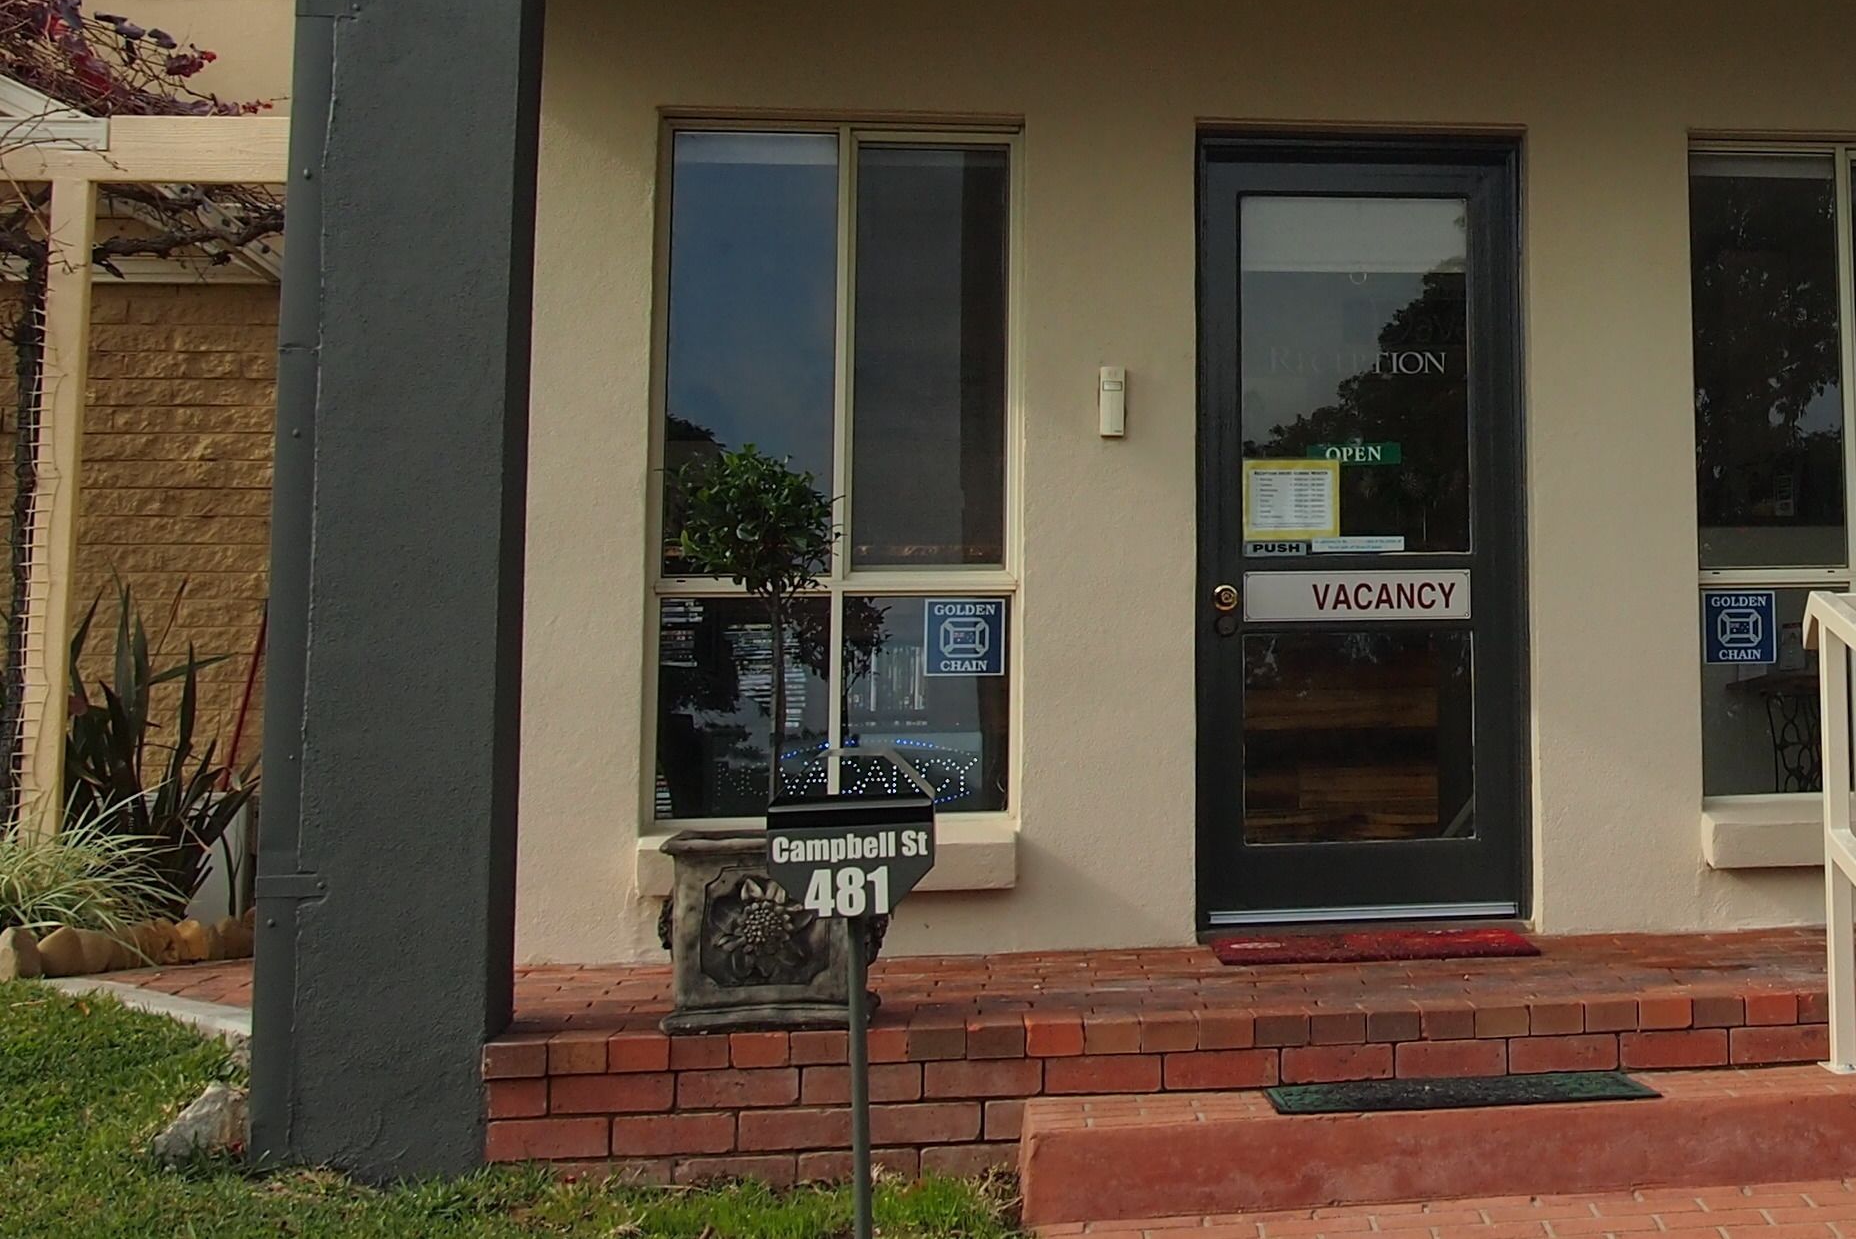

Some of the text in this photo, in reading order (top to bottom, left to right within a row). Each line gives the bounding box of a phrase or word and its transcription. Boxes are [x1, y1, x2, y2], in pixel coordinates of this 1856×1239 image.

[1325, 445, 1382, 462] OPEN
[1253, 543, 1300, 553] PUSH
[1312, 582, 1455, 610] VACANCY
[1711, 596, 1766, 607] GOLDEN
[934, 603, 996, 617] GOLDEN
[1719, 649, 1761, 660] CHAIN
[940, 659, 988, 672] CHAIN
[772, 830, 929, 864] Campbell St
[804, 865, 890, 918] 481
